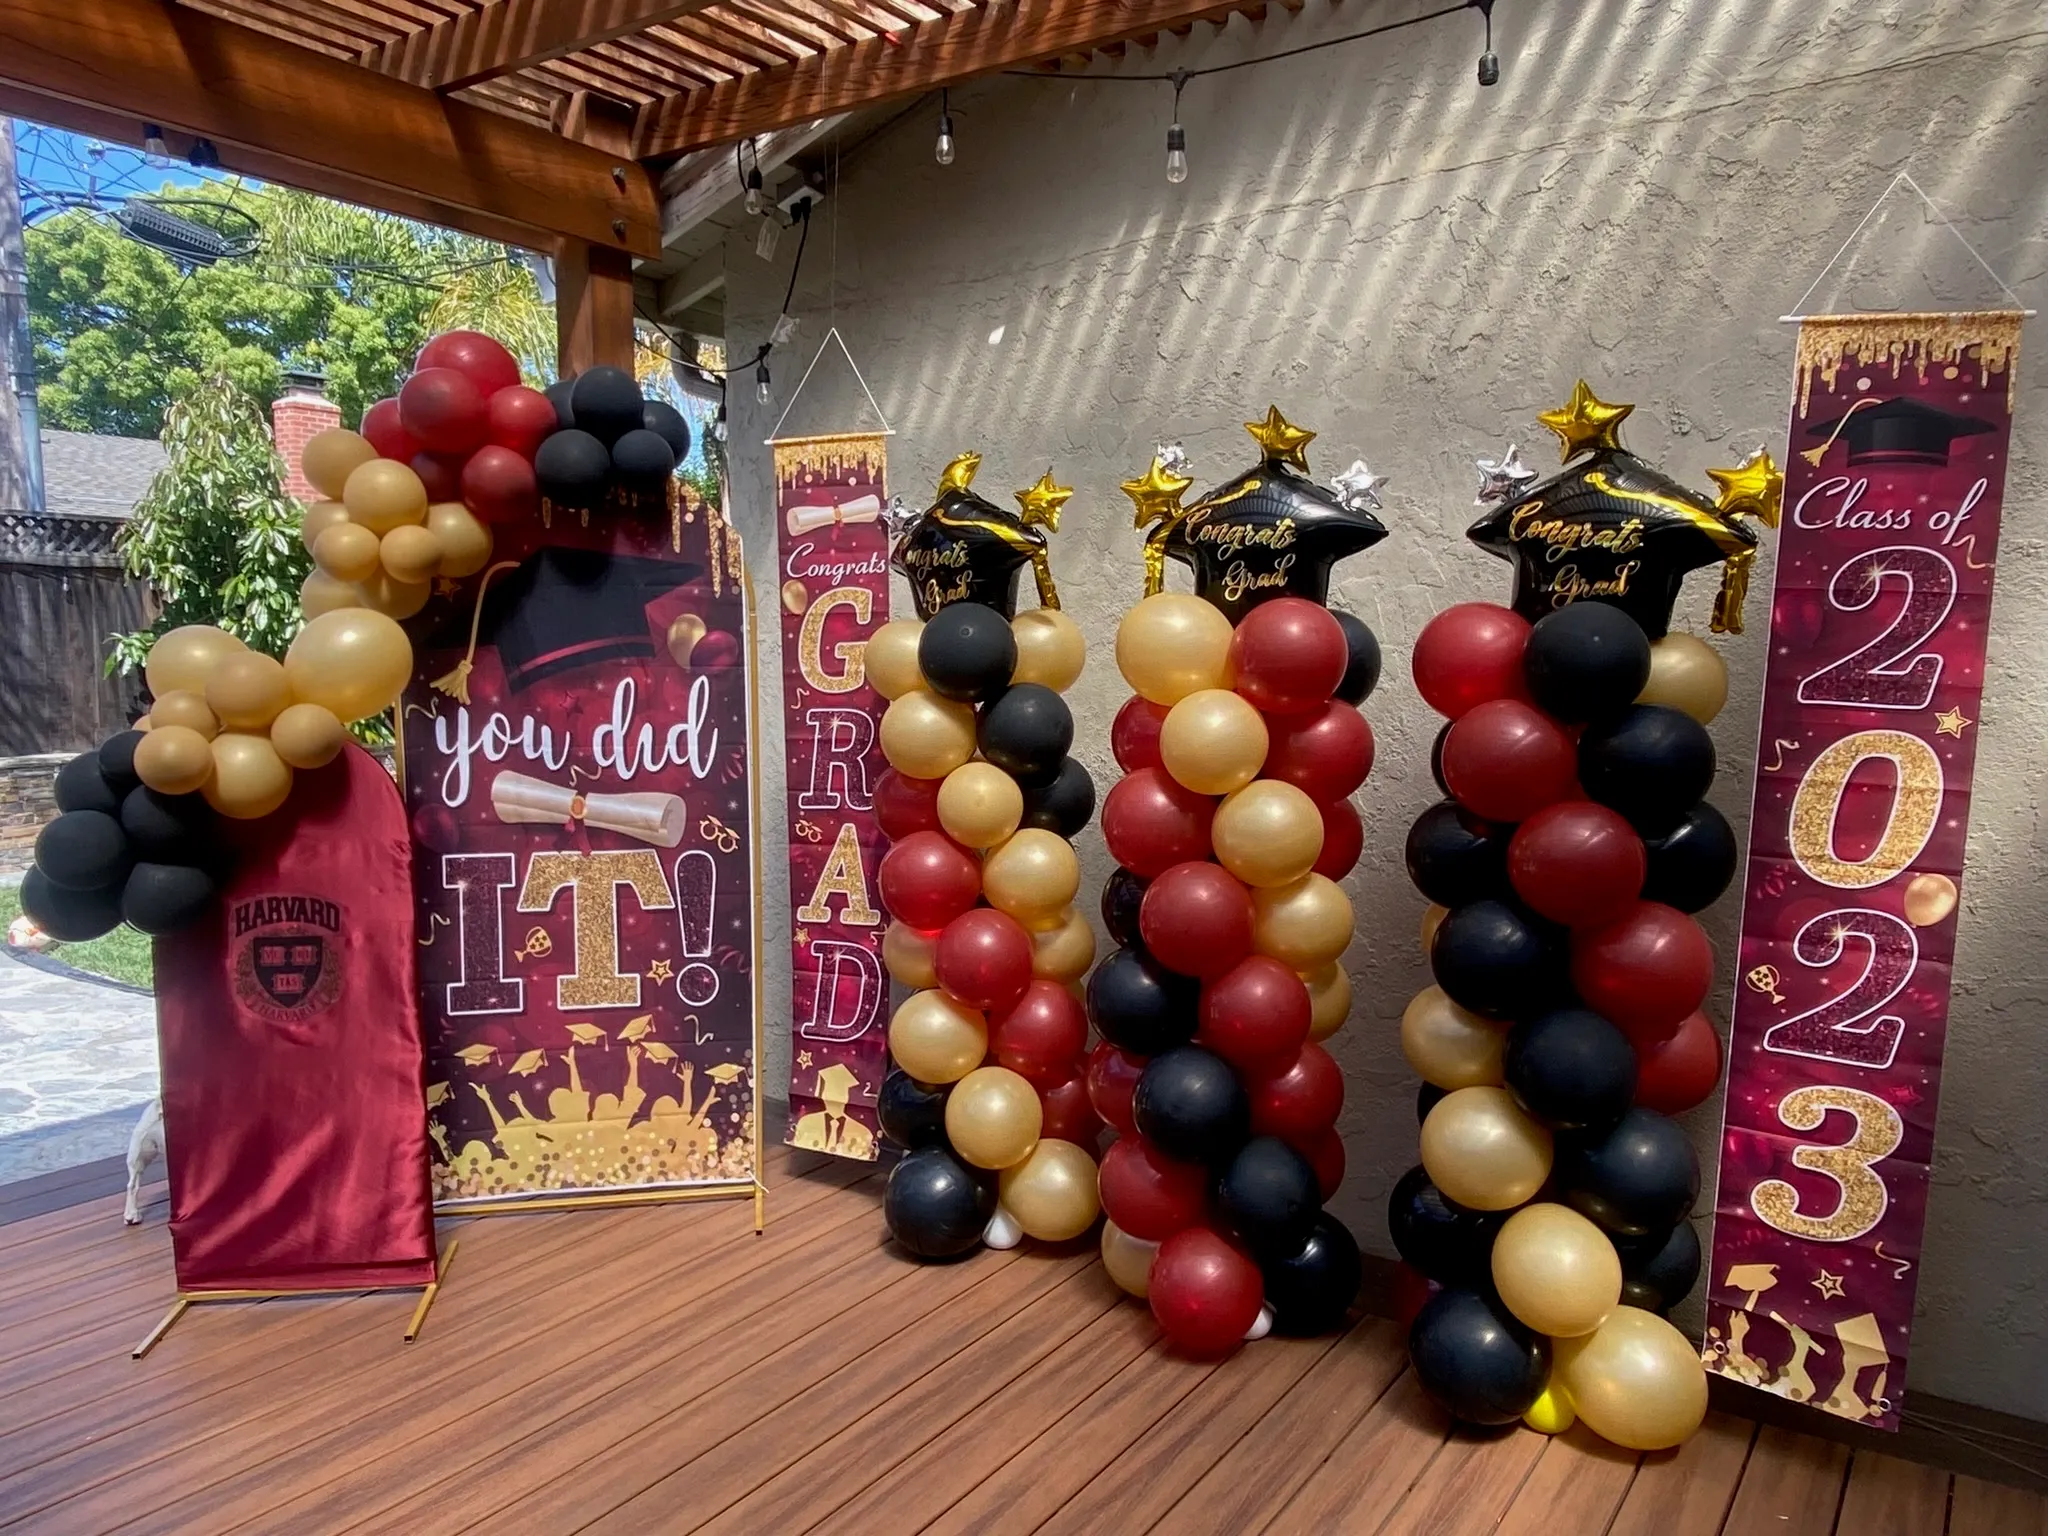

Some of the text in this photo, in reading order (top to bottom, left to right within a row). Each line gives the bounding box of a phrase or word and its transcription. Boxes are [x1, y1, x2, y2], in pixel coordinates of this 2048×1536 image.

[1184, 507, 1297, 562] Congrats
[1508, 501, 1644, 562] Congrats
[1793, 475, 1988, 546] Class of
[786, 542, 886, 586] Congrats
[1221, 553, 1296, 601] Grad
[1547, 560, 1641, 610] Grad
[924, 569, 973, 615] Grad
[434, 674, 719, 808] you did
[235, 896, 340, 937] HARVARD
[441, 848, 720, 1015] IT!
